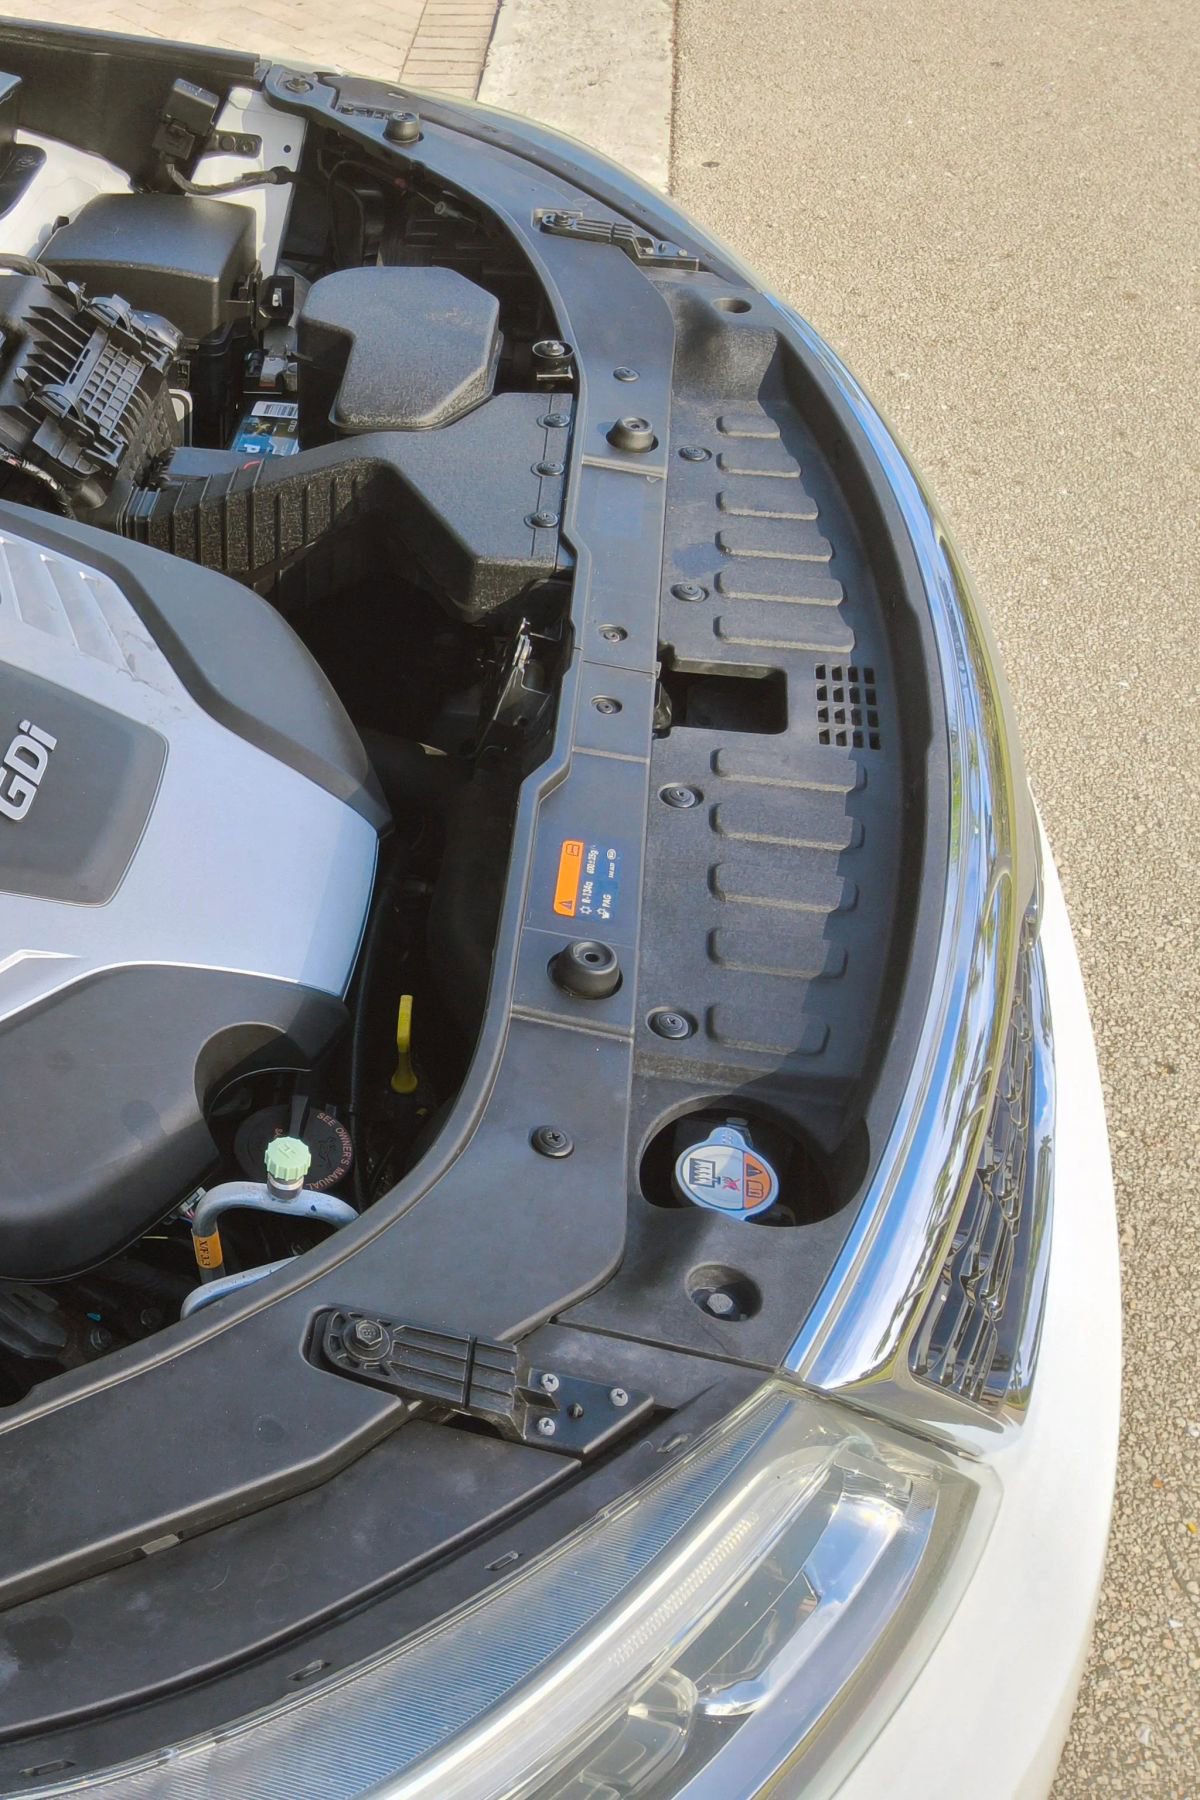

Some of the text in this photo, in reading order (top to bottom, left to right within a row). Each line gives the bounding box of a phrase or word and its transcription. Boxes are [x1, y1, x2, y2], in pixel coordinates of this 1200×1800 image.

[602, 894, 611, 908] PAG
[317, 1112, 336, 1127] SEE
[335, 1127, 352, 1166] OWNER'S
